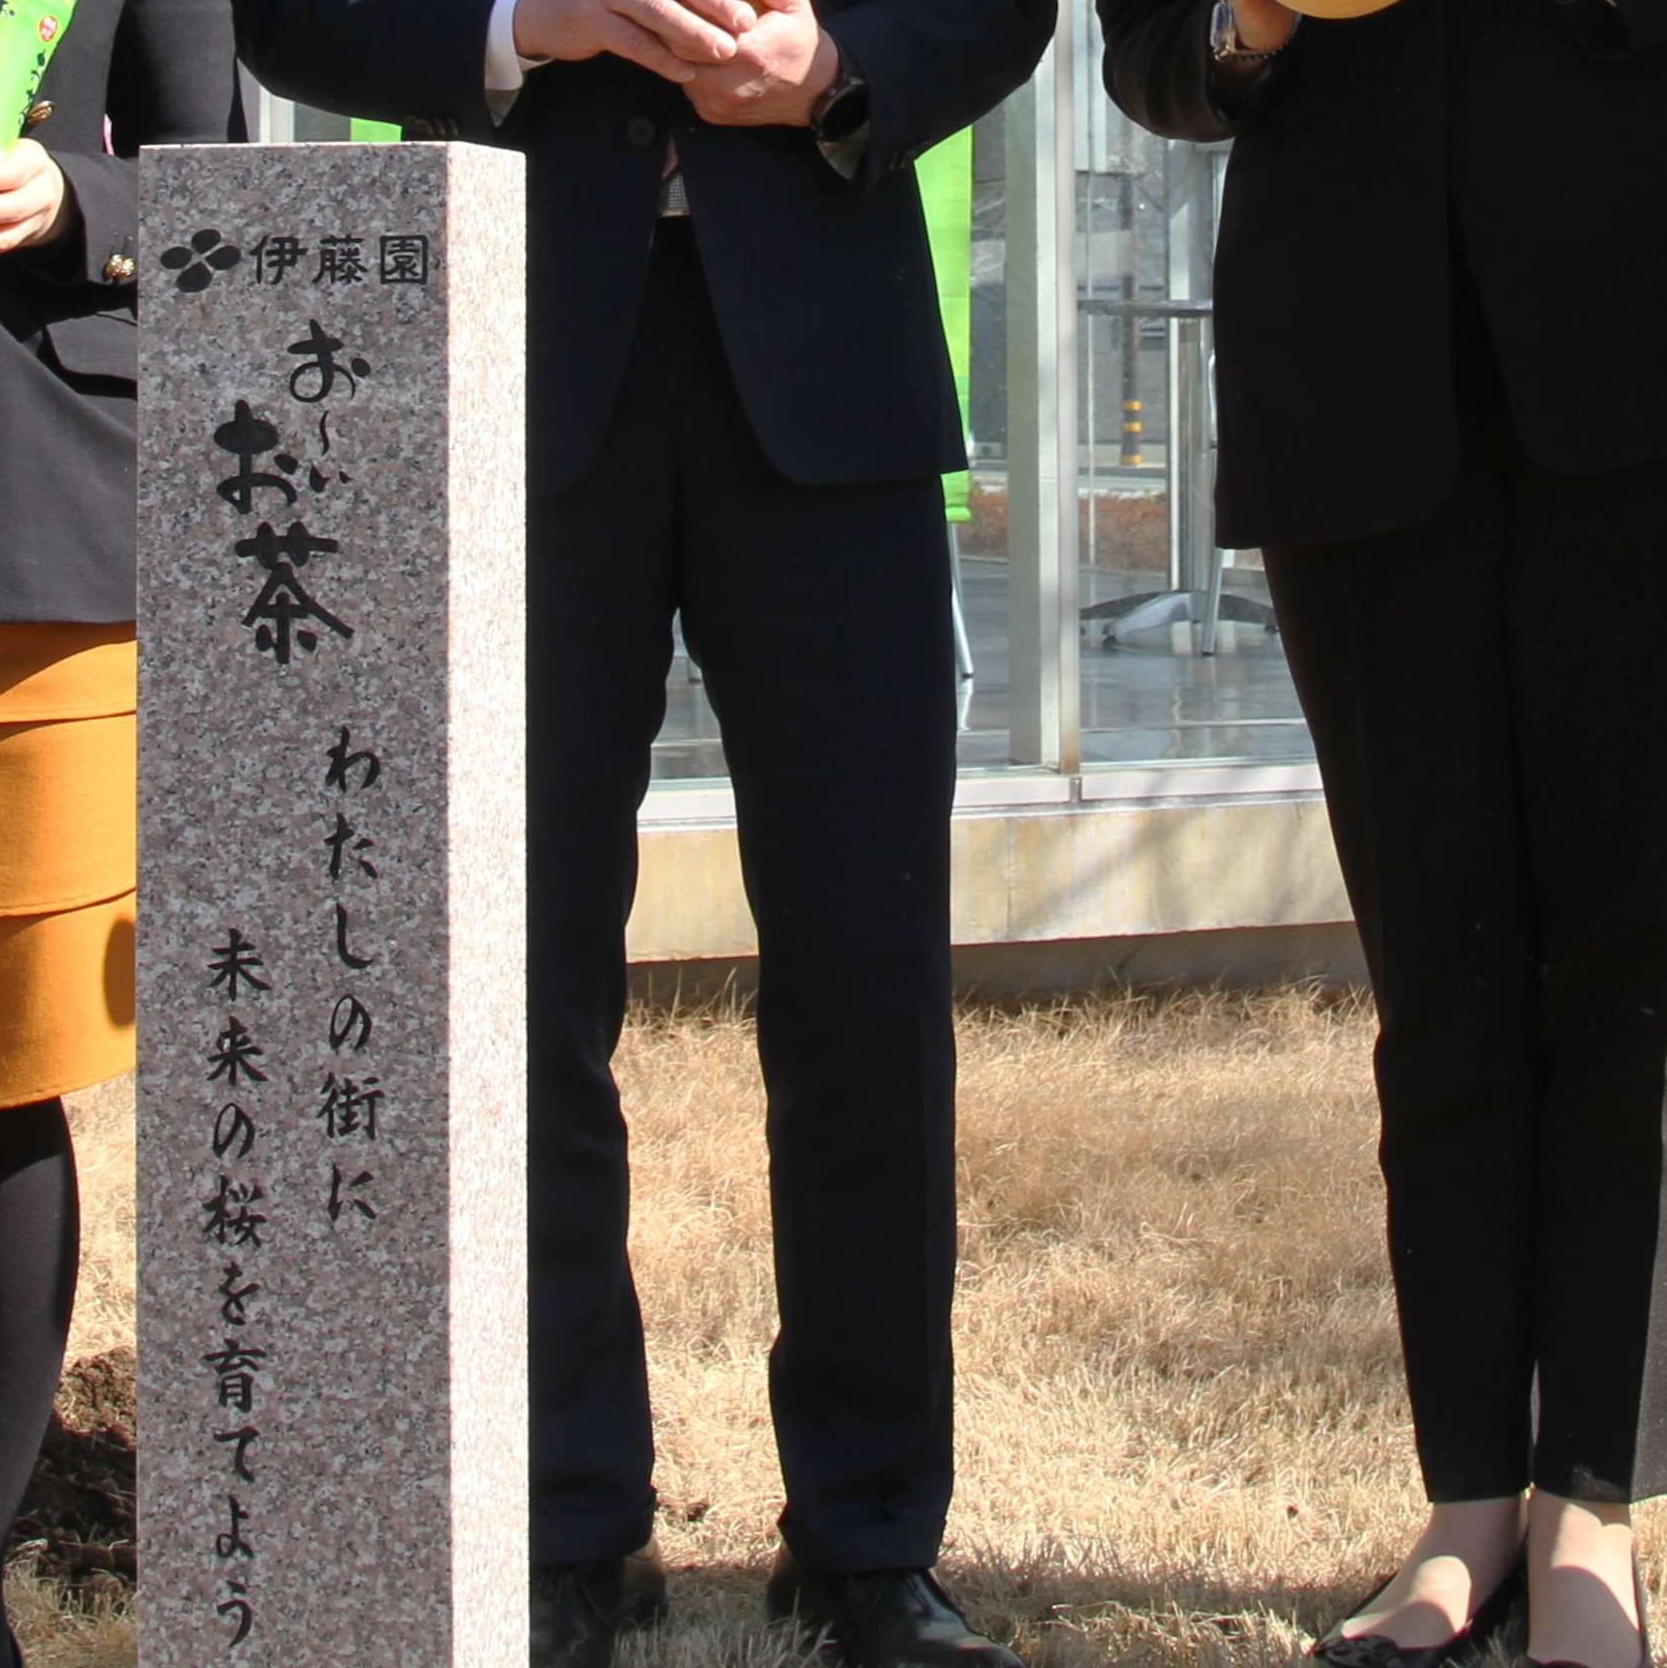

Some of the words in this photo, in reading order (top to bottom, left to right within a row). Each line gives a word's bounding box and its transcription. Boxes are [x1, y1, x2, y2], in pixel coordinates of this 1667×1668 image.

[248, 234, 429, 285] 伊藤園
[213, 399, 355, 664] お茶
[317, 726, 384, 1221] わたしの街に
[202, 928, 272, 1649] 未来の桜を育てよう
